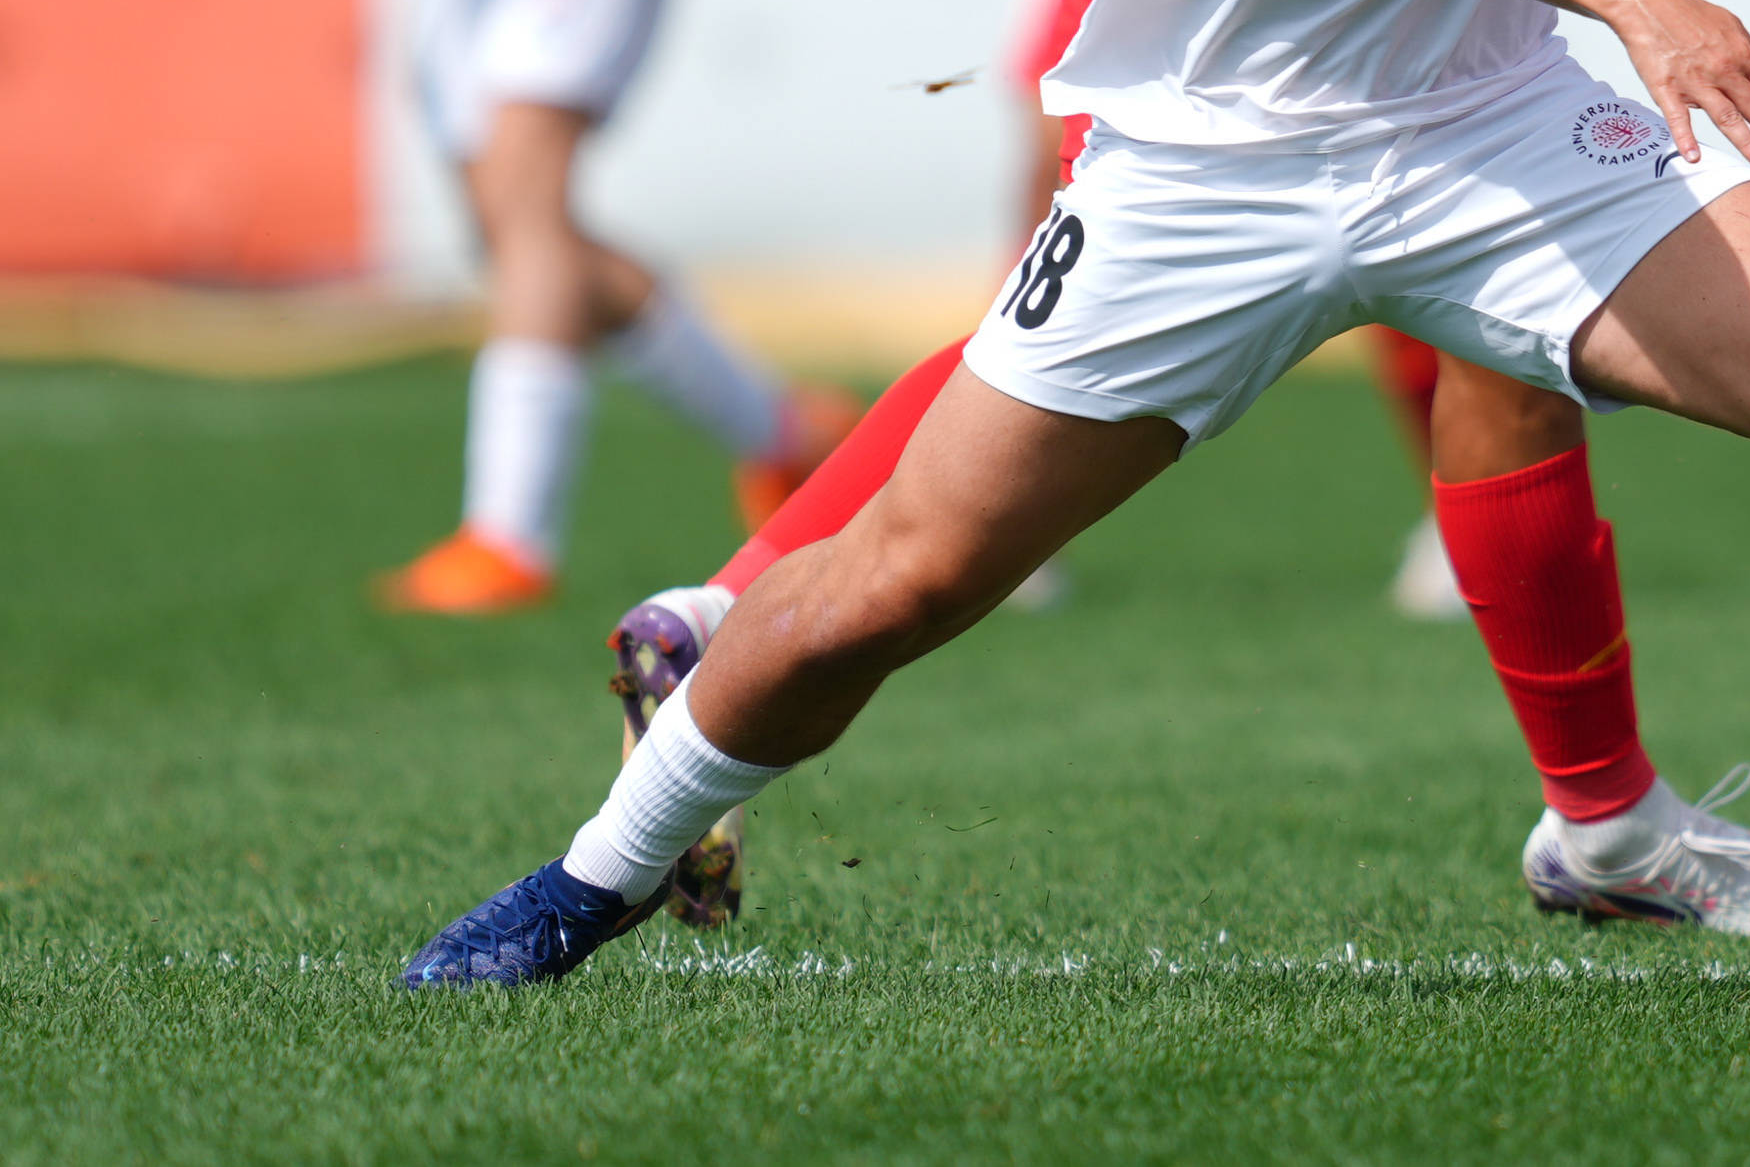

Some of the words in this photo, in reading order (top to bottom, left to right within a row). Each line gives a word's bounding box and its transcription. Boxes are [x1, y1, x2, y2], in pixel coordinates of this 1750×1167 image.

[1570, 102, 1640, 155] UNIVERSITA
[1596, 141, 1661, 166] RAMON
[1000, 206, 1085, 330] 18
